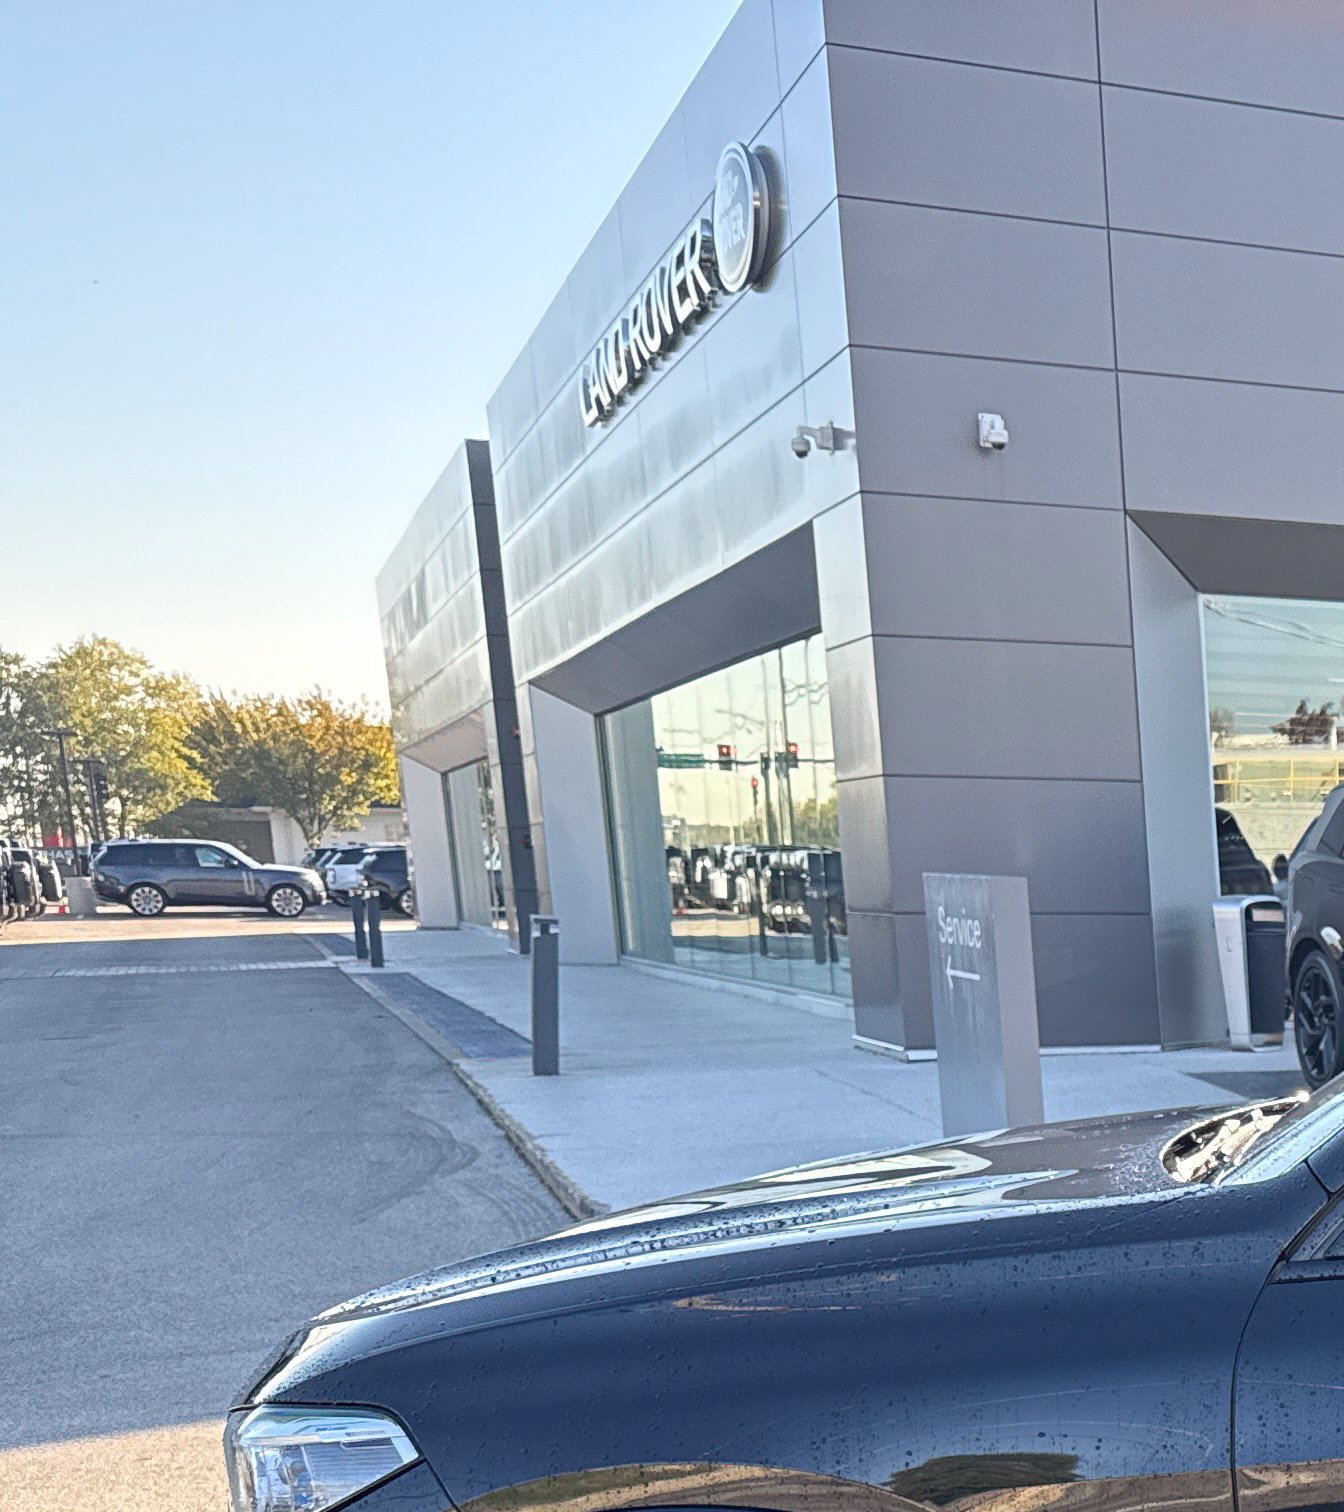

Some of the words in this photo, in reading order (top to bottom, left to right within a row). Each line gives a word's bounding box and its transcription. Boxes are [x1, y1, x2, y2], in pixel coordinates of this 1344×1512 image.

[579, 319, 630, 426] LAND
[628, 221, 712, 369] ROVER
[937, 906, 982, 949] Service
